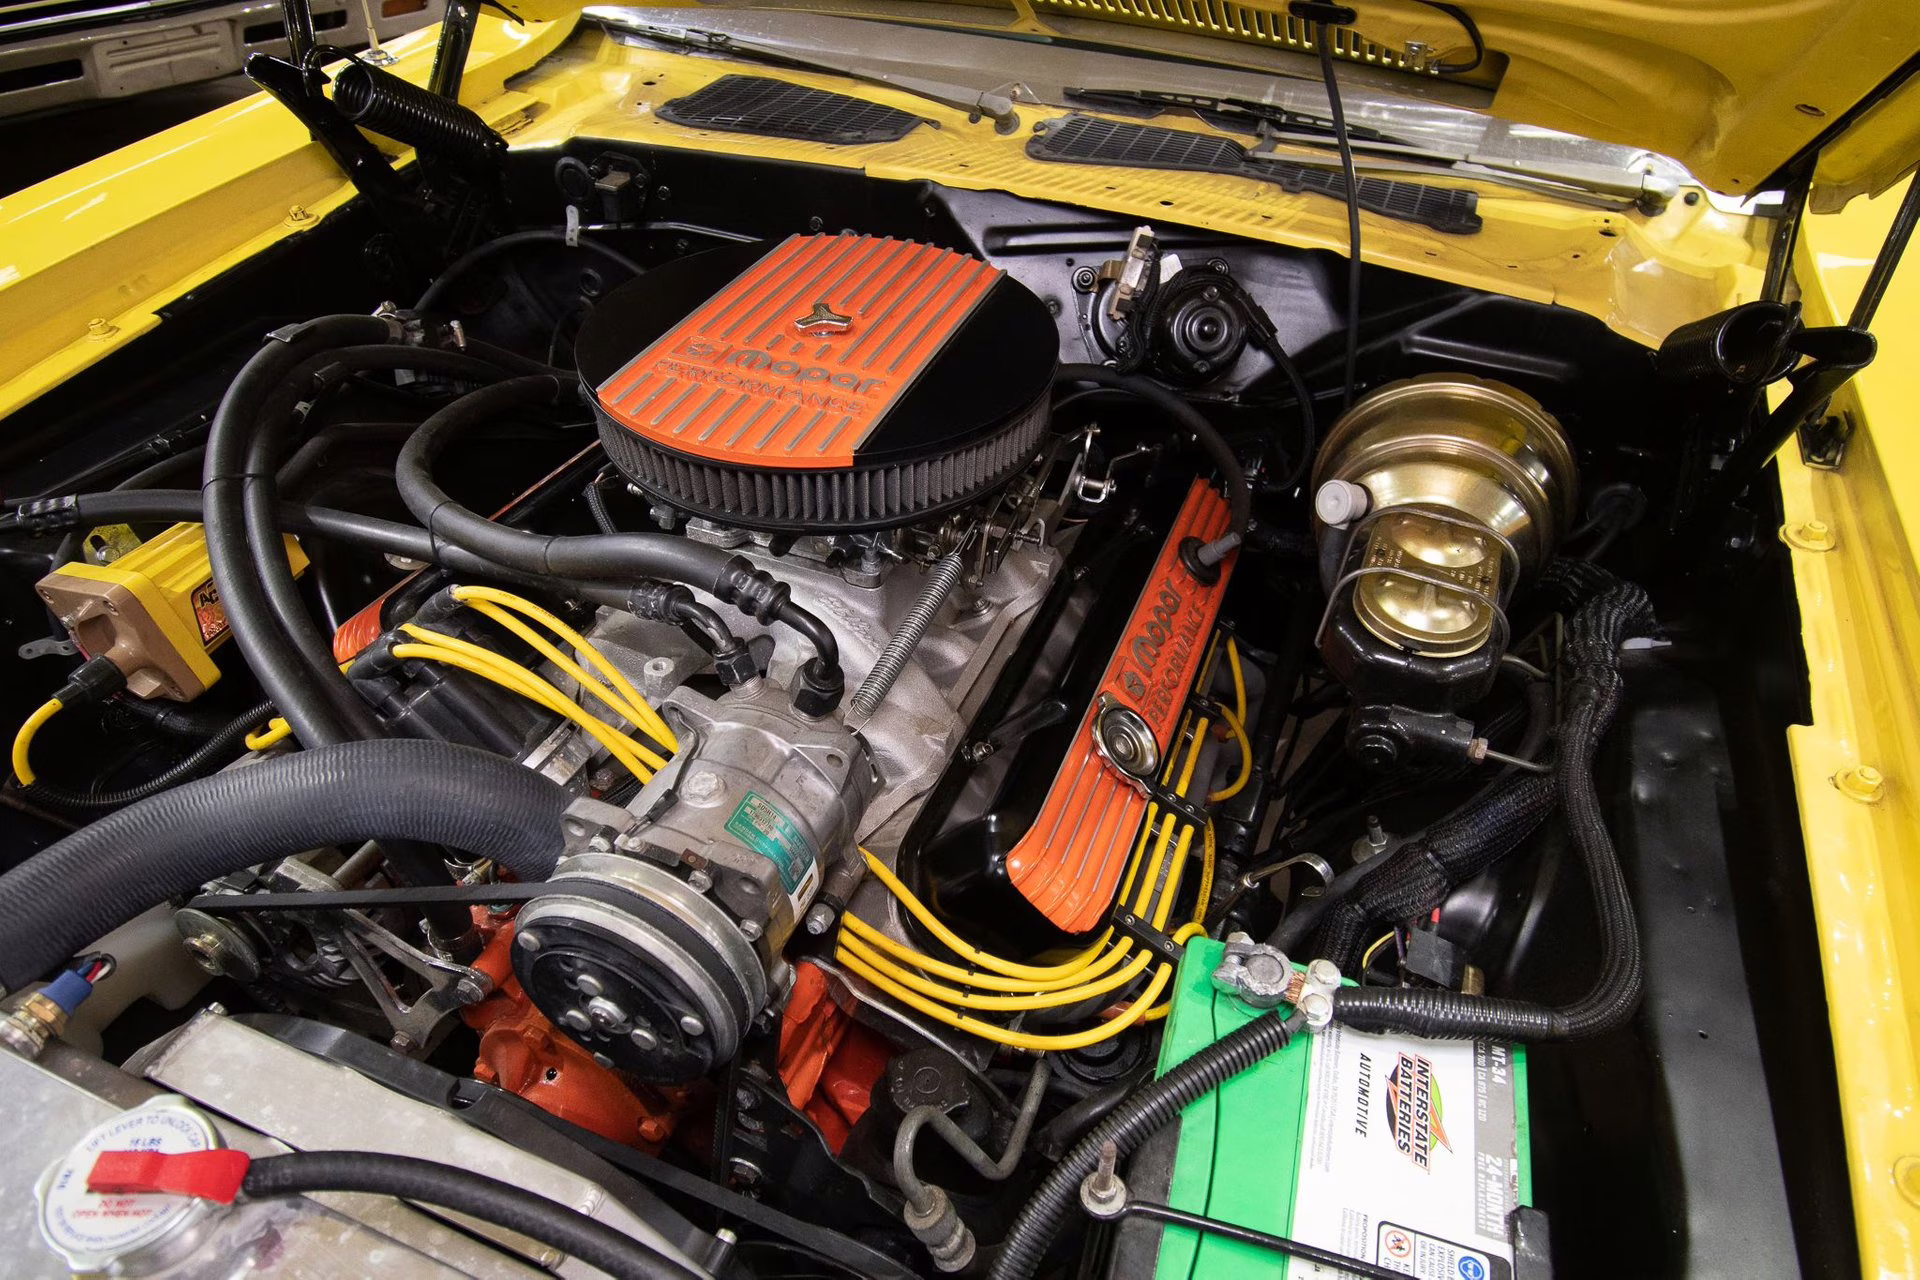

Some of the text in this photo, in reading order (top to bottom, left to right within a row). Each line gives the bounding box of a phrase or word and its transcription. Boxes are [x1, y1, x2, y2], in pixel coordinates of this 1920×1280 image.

[653, 359, 865, 413] PERFORMANCE
[1150, 602, 1204, 725] PERFORMANCE
[1477, 1041, 1486, 1054] CCA
[1477, 1054, 1486, 1067] 700
[1491, 1045, 1506, 1085] MT-34
[1355, 1052, 1372, 1138] AUTOMOTIVE
[1477, 1071, 1486, 1080] CA
[109, 1116, 143, 1137] LEVER
[1398, 1056, 1413, 1154] BATTERIES
[1414, 1058, 1430, 1167] INTERSTATE
[1477, 1151, 1487, 1230] FREE REPLACEMENT
[1485, 1154, 1504, 1236] 24-MONTH
[1360, 1213, 1369, 1259] PROPOSITION
[1437, 1245, 1446, 1280] EXPLOSIV
[1446, 1248, 1456, 1276] SHIELD
